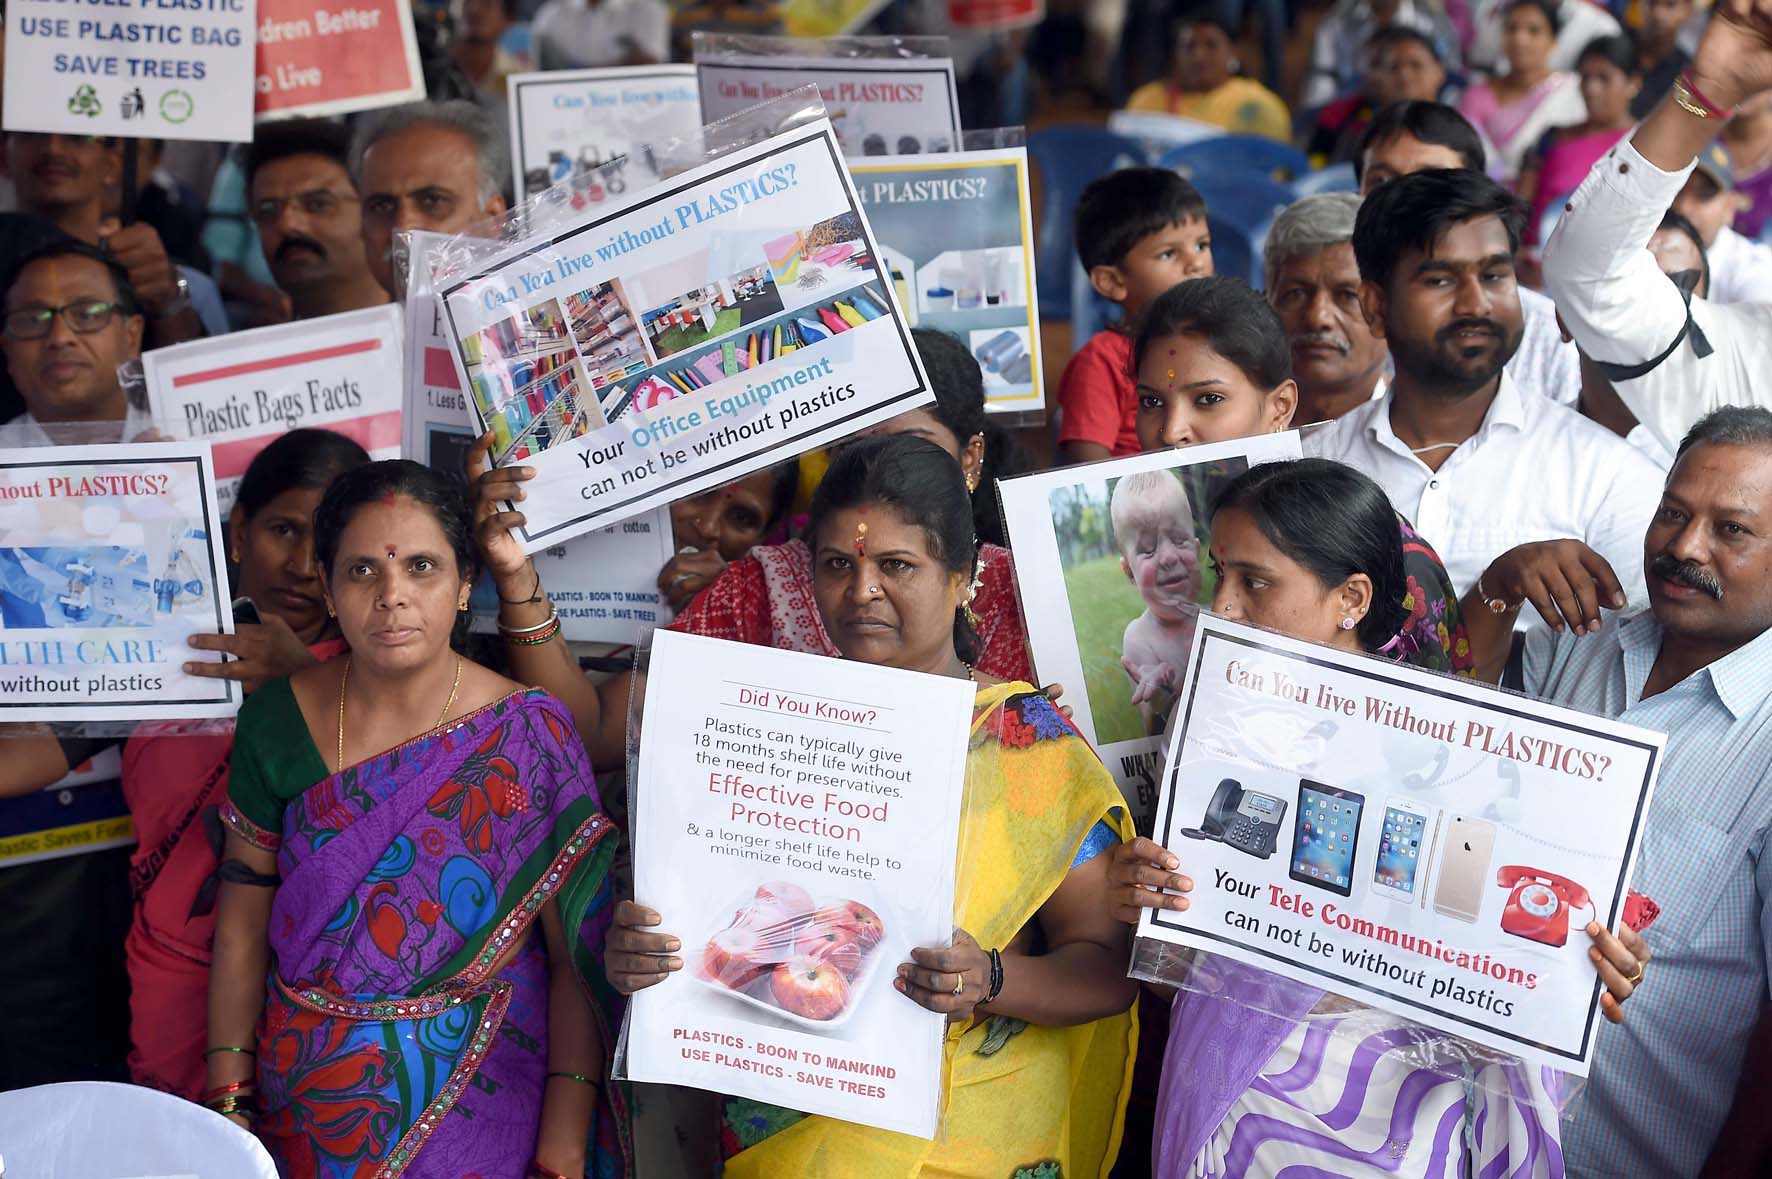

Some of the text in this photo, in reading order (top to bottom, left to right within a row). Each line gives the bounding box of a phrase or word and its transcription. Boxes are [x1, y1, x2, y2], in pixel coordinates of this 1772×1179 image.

[21, 16, 242, 47] USE PLASTIC BAG
[314, 9, 381, 36] Better
[54, 54, 207, 80] SAVE TREES
[276, 64, 321, 91] Live
[840, 82, 924, 104] PLASTICS?
[873, 176, 987, 203] PLASTICS?
[484, 163, 798, 311] Can You live without PLASTICS?
[183, 377, 362, 437] Plastic Bags Facts
[436, 393, 456, 410] Less
[577, 356, 833, 469] Your Office Equipment
[581, 383, 856, 500] can not be without plastics
[48, 474, 168, 497] PLASTICS?
[623, 521, 651, 534] cotton
[547, 591, 583, 602] PLASTICS
[589, 592, 612, 601] BOON
[614, 592, 624, 601] TO
[570, 608, 607, 618] PLASTICS
[612, 609, 632, 619] SAVE
[633, 609, 657, 622] TREES
[77, 639, 168, 664] CARE
[1, 674, 162, 696] without plastics
[739, 688, 877, 725] Did You Know?
[1226, 660, 1612, 783] Can You live Without PLASTICS?
[693, 732, 912, 783] 18 months shelf life without
[705, 717, 902, 764] Plastics can typically give
[695, 751, 904, 799] the need for preservatives.
[708, 772, 889, 823] Effective Food
[731, 802, 862, 843] Protection
[686, 822, 902, 870] & a longer shelf life help to
[710, 843, 876, 881] minimize food waste.
[1214, 868, 1538, 990] Your Tele Communications
[1225, 910, 1515, 1017] can not be without plastics
[673, 1028, 744, 1049] PLASTICS
[756, 1042, 798, 1062] BOON
[802, 1051, 822, 1066] TO
[826, 1056, 897, 1080] MANKIND
[681, 1047, 711, 1062] USE
[715, 1053, 784, 1078] PLASTICS
[796, 1071, 834, 1090] SAVE
[838, 1079, 887, 1099] TREES
